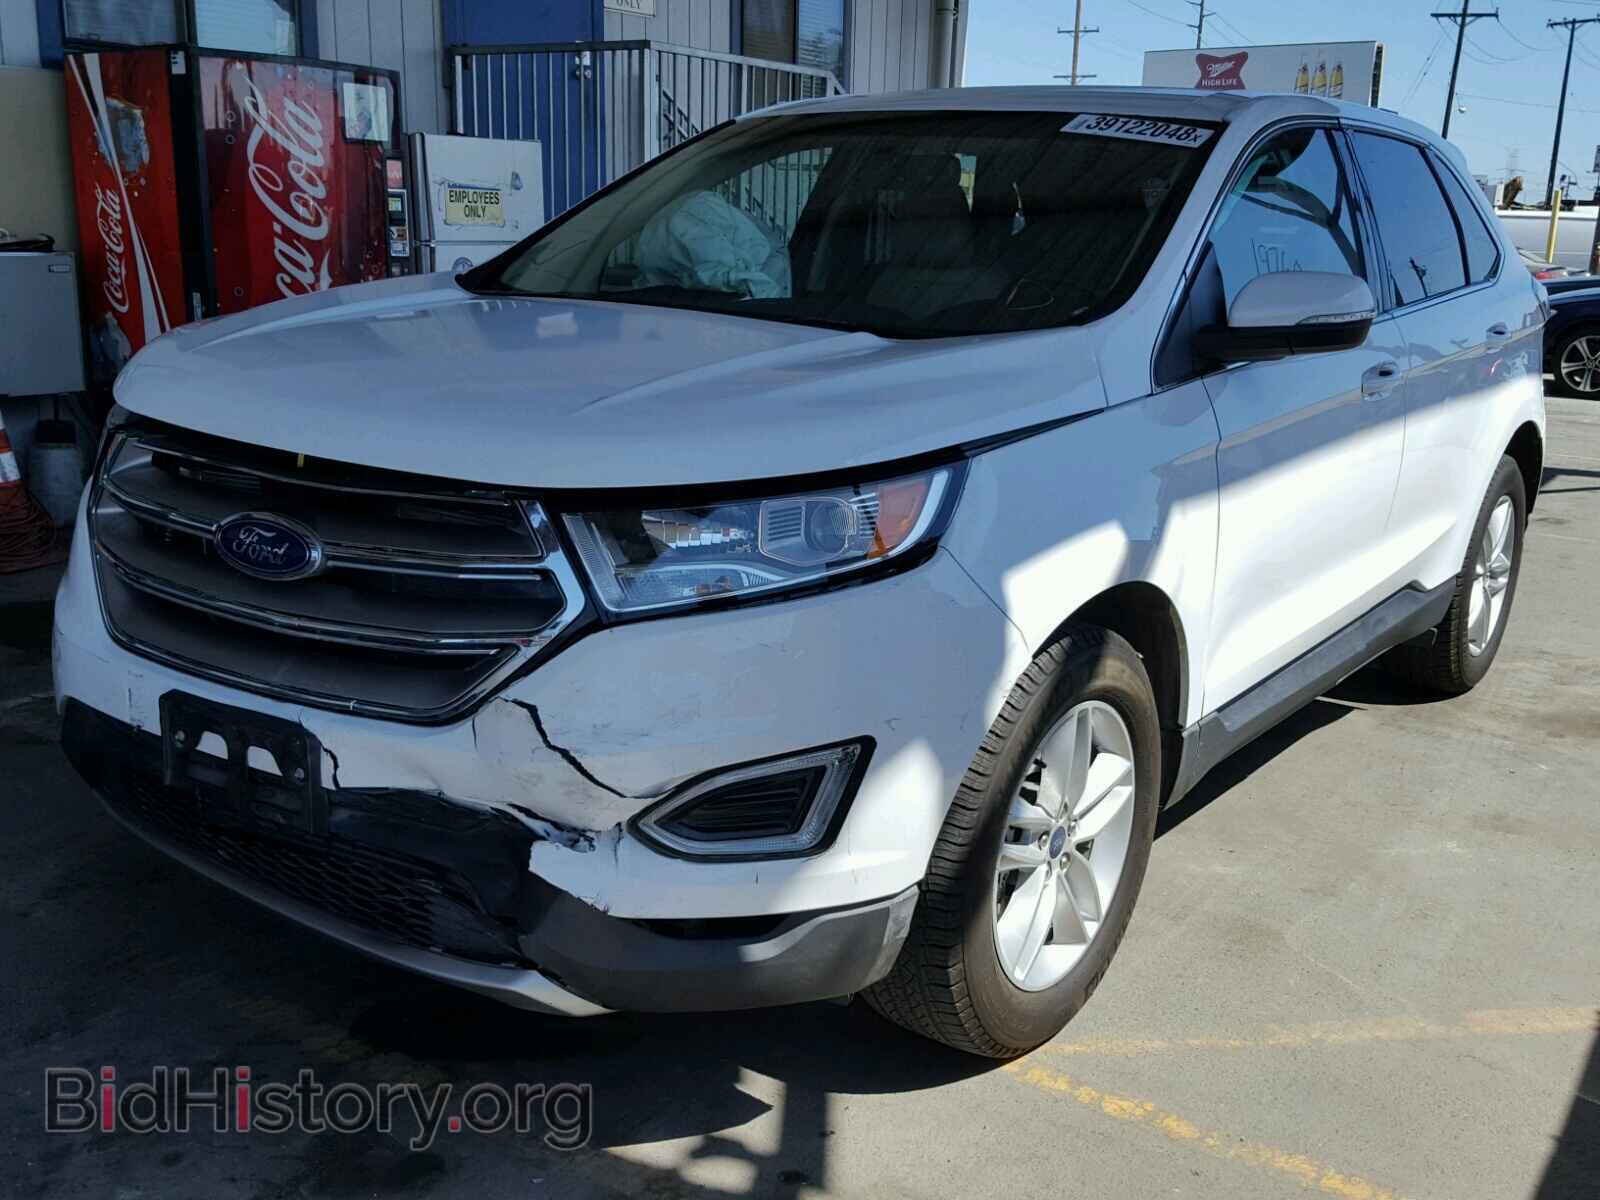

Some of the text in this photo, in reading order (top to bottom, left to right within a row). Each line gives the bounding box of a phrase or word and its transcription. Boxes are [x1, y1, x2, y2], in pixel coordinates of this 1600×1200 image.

[1201, 78, 1238, 87] HIGH LIFE
[448, 190, 500, 205] EMPLOYEES
[463, 204, 487, 218] ONLY
[232, 525, 289, 564] Ford
